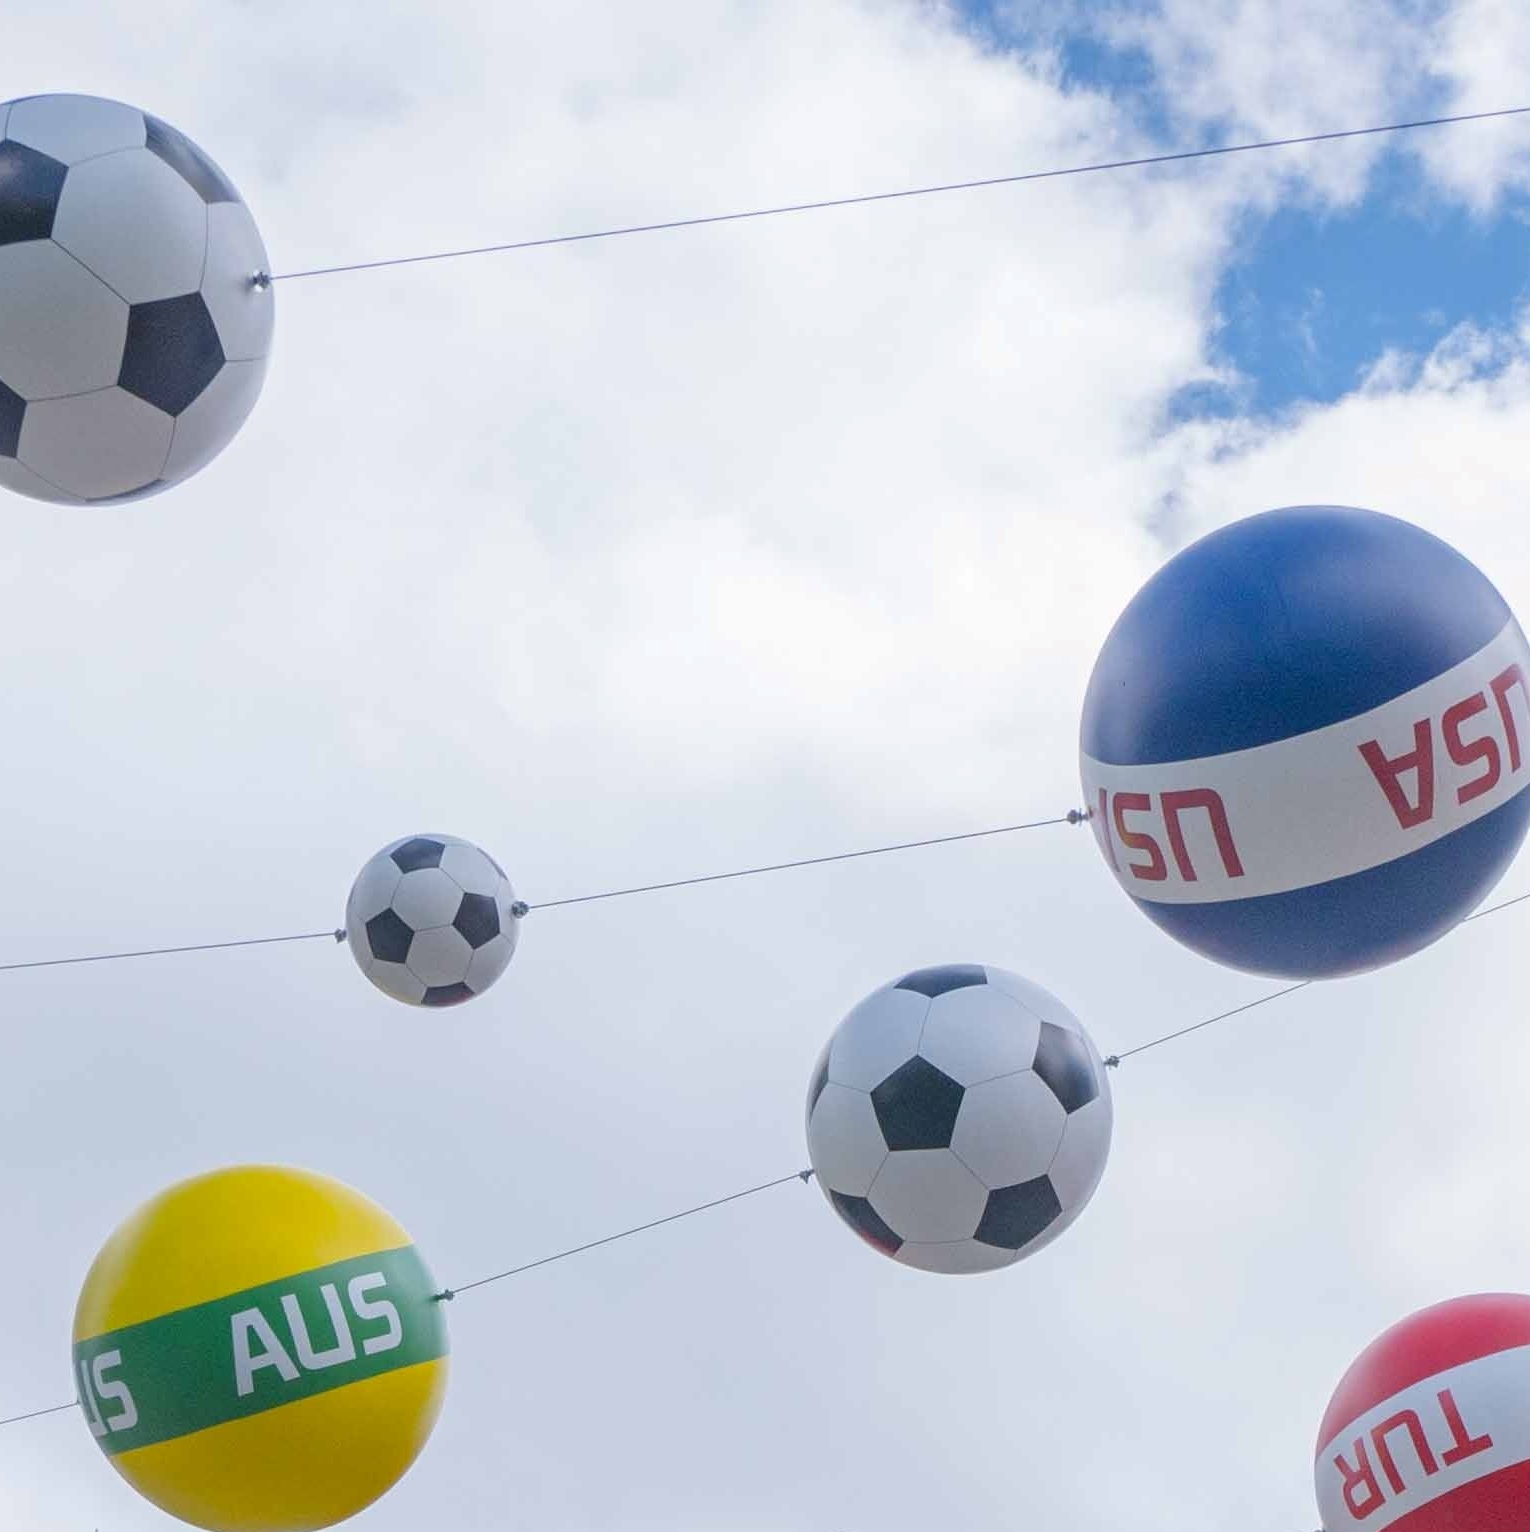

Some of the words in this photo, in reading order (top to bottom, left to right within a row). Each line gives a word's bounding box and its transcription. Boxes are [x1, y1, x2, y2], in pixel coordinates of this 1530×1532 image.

[1099, 788, 1245, 881] US
[230, 1272, 403, 1397] AUS
[75, 1349, 138, 1437] US
[1332, 1388, 1494, 1521] TUR
